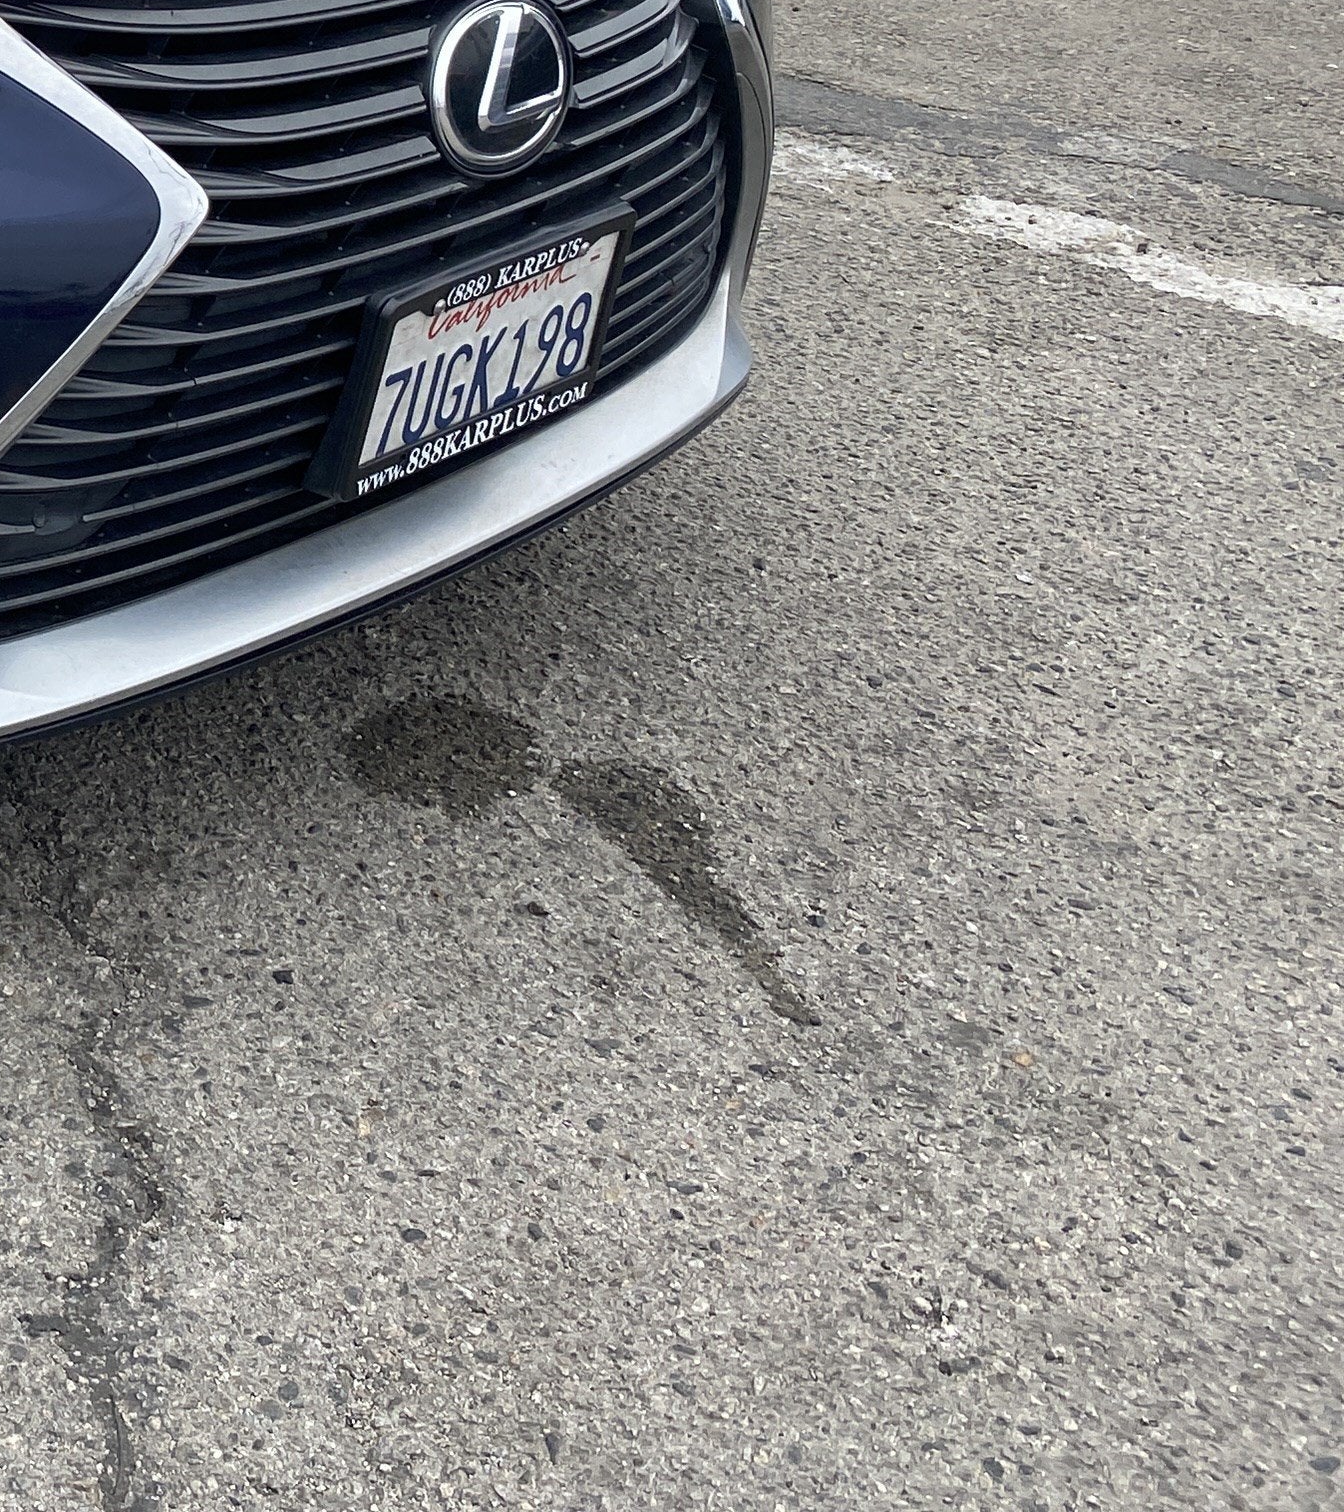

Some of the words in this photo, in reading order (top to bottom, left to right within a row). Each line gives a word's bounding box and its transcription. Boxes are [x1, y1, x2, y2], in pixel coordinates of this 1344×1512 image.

[428, 263, 576, 340] California
[445, 274, 492, 309] (888)
[375, 291, 592, 458] 7UGK198
[356, 382, 588, 497] www.888KARPLUS.COM
